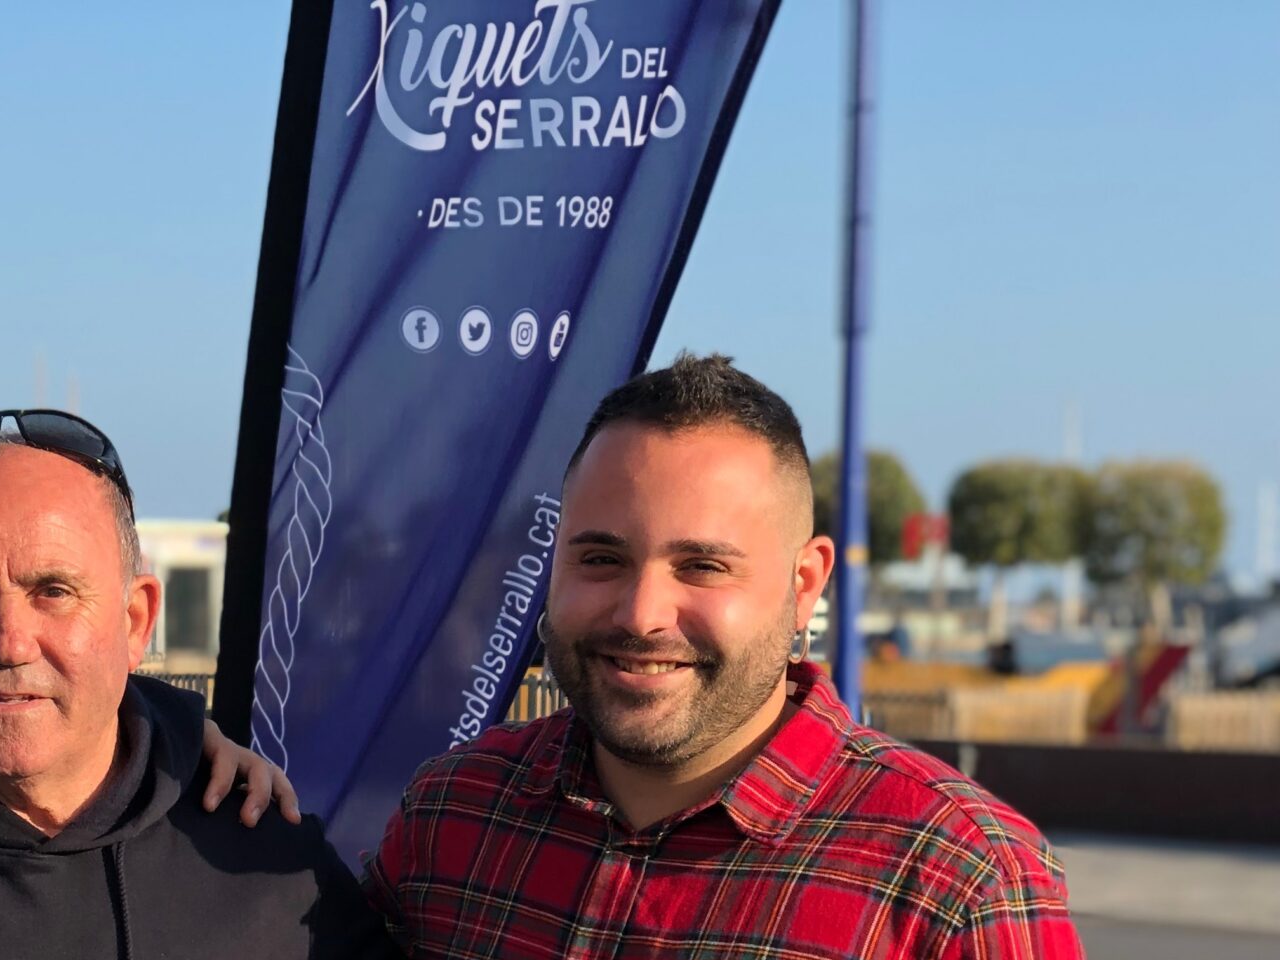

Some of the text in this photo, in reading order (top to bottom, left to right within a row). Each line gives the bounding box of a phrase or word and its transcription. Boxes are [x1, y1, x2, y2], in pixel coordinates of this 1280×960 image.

[621, 47, 668, 79] DEL
[498, 195, 544, 226] DE
[556, 196, 613, 228] 1988
[448, 491, 562, 750] tsdelserrallo.cat
